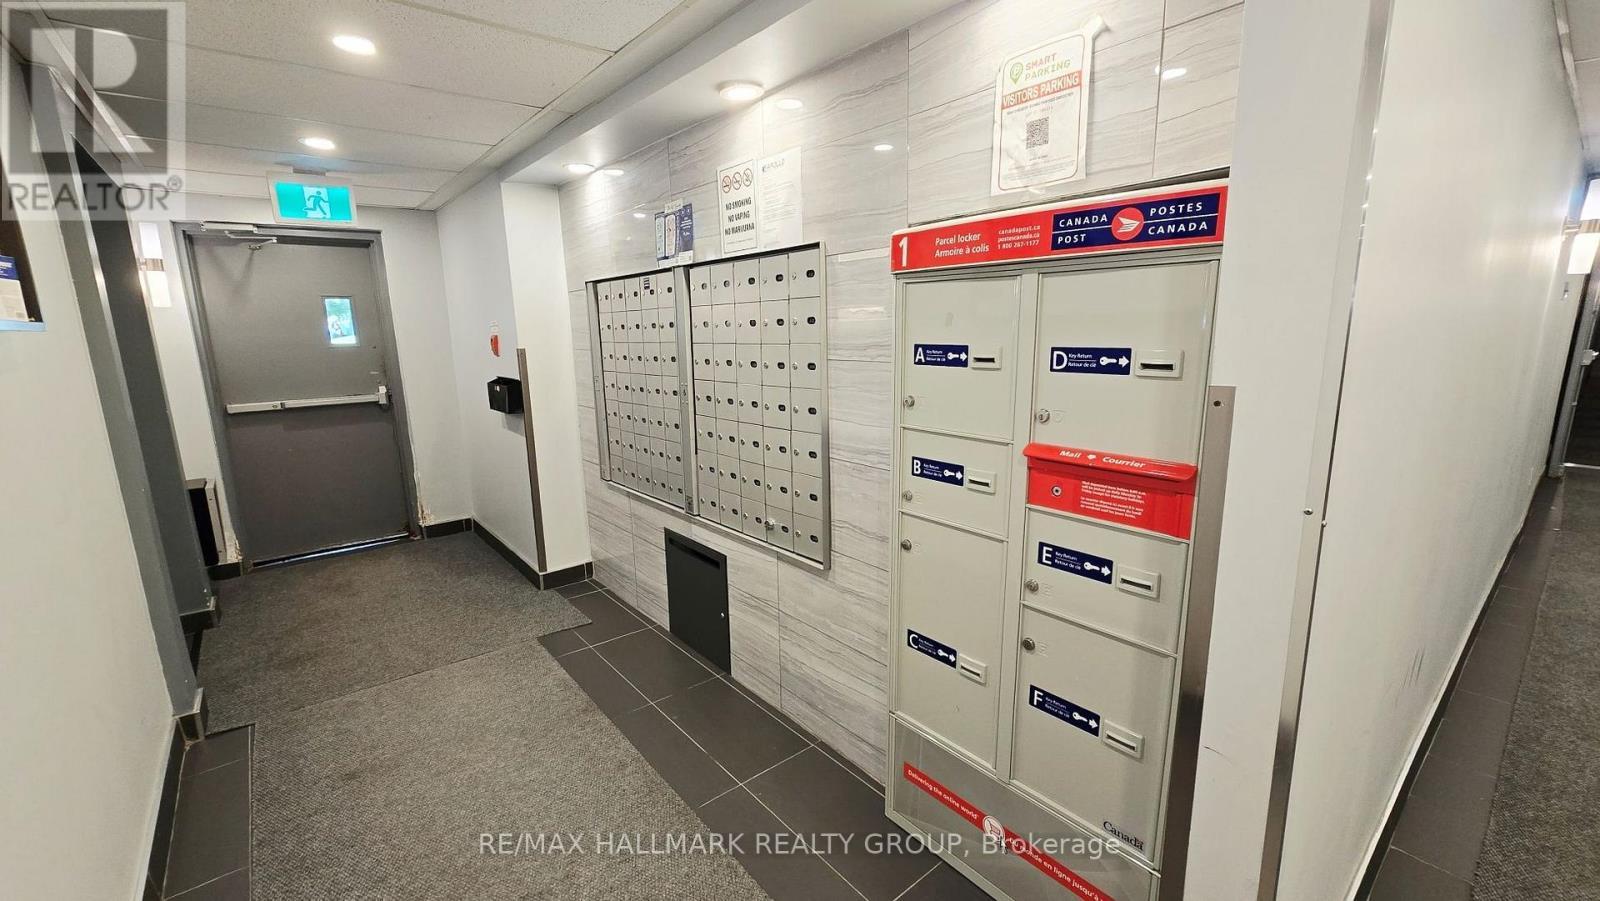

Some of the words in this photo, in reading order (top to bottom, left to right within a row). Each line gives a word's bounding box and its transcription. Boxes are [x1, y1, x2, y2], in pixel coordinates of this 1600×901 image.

[1026, 53, 1056, 70] SMART
[1025, 60, 1071, 80] PARKING
[1003, 86, 1040, 106] VISITORS
[1040, 72, 1080, 96] PARKING
[732, 196, 752, 209] SMOKING
[1150, 202, 1203, 216] POSTES
[728, 214, 734, 222] NO
[734, 210, 750, 220] VAPING
[1058, 214, 1108, 228] CANADA
[998, 225, 1040, 235] canadapost.ca
[1148, 221, 1208, 235] CANADA
[935, 234, 956, 246] Parcel
[958, 232, 981, 244] locker
[998, 232, 1040, 243] postescanada.ca
[1058, 233, 1087, 244] POST
[898, 236, 908, 268] 1
[934, 248, 964, 258] Armoire
[965, 246, 970, 254] à
[972, 243, 990, 254] colis
[914, 347, 926, 362] A
[1052, 351, 1068, 370] D
[1059, 450, 1082, 459] Mail
[1102, 456, 1146, 468] Courrier
[914, 460, 921, 474] B
[1042, 546, 1053, 564] E
[910, 634, 918, 648] C
[1034, 690, 1044, 706] F
[908, 769, 933, 791] Delivering
[934, 785, 942, 796] the
[1103, 820, 1144, 851] Canada
[1043, 860, 1052, 870] en
[1054, 867, 1071, 882] ligne
